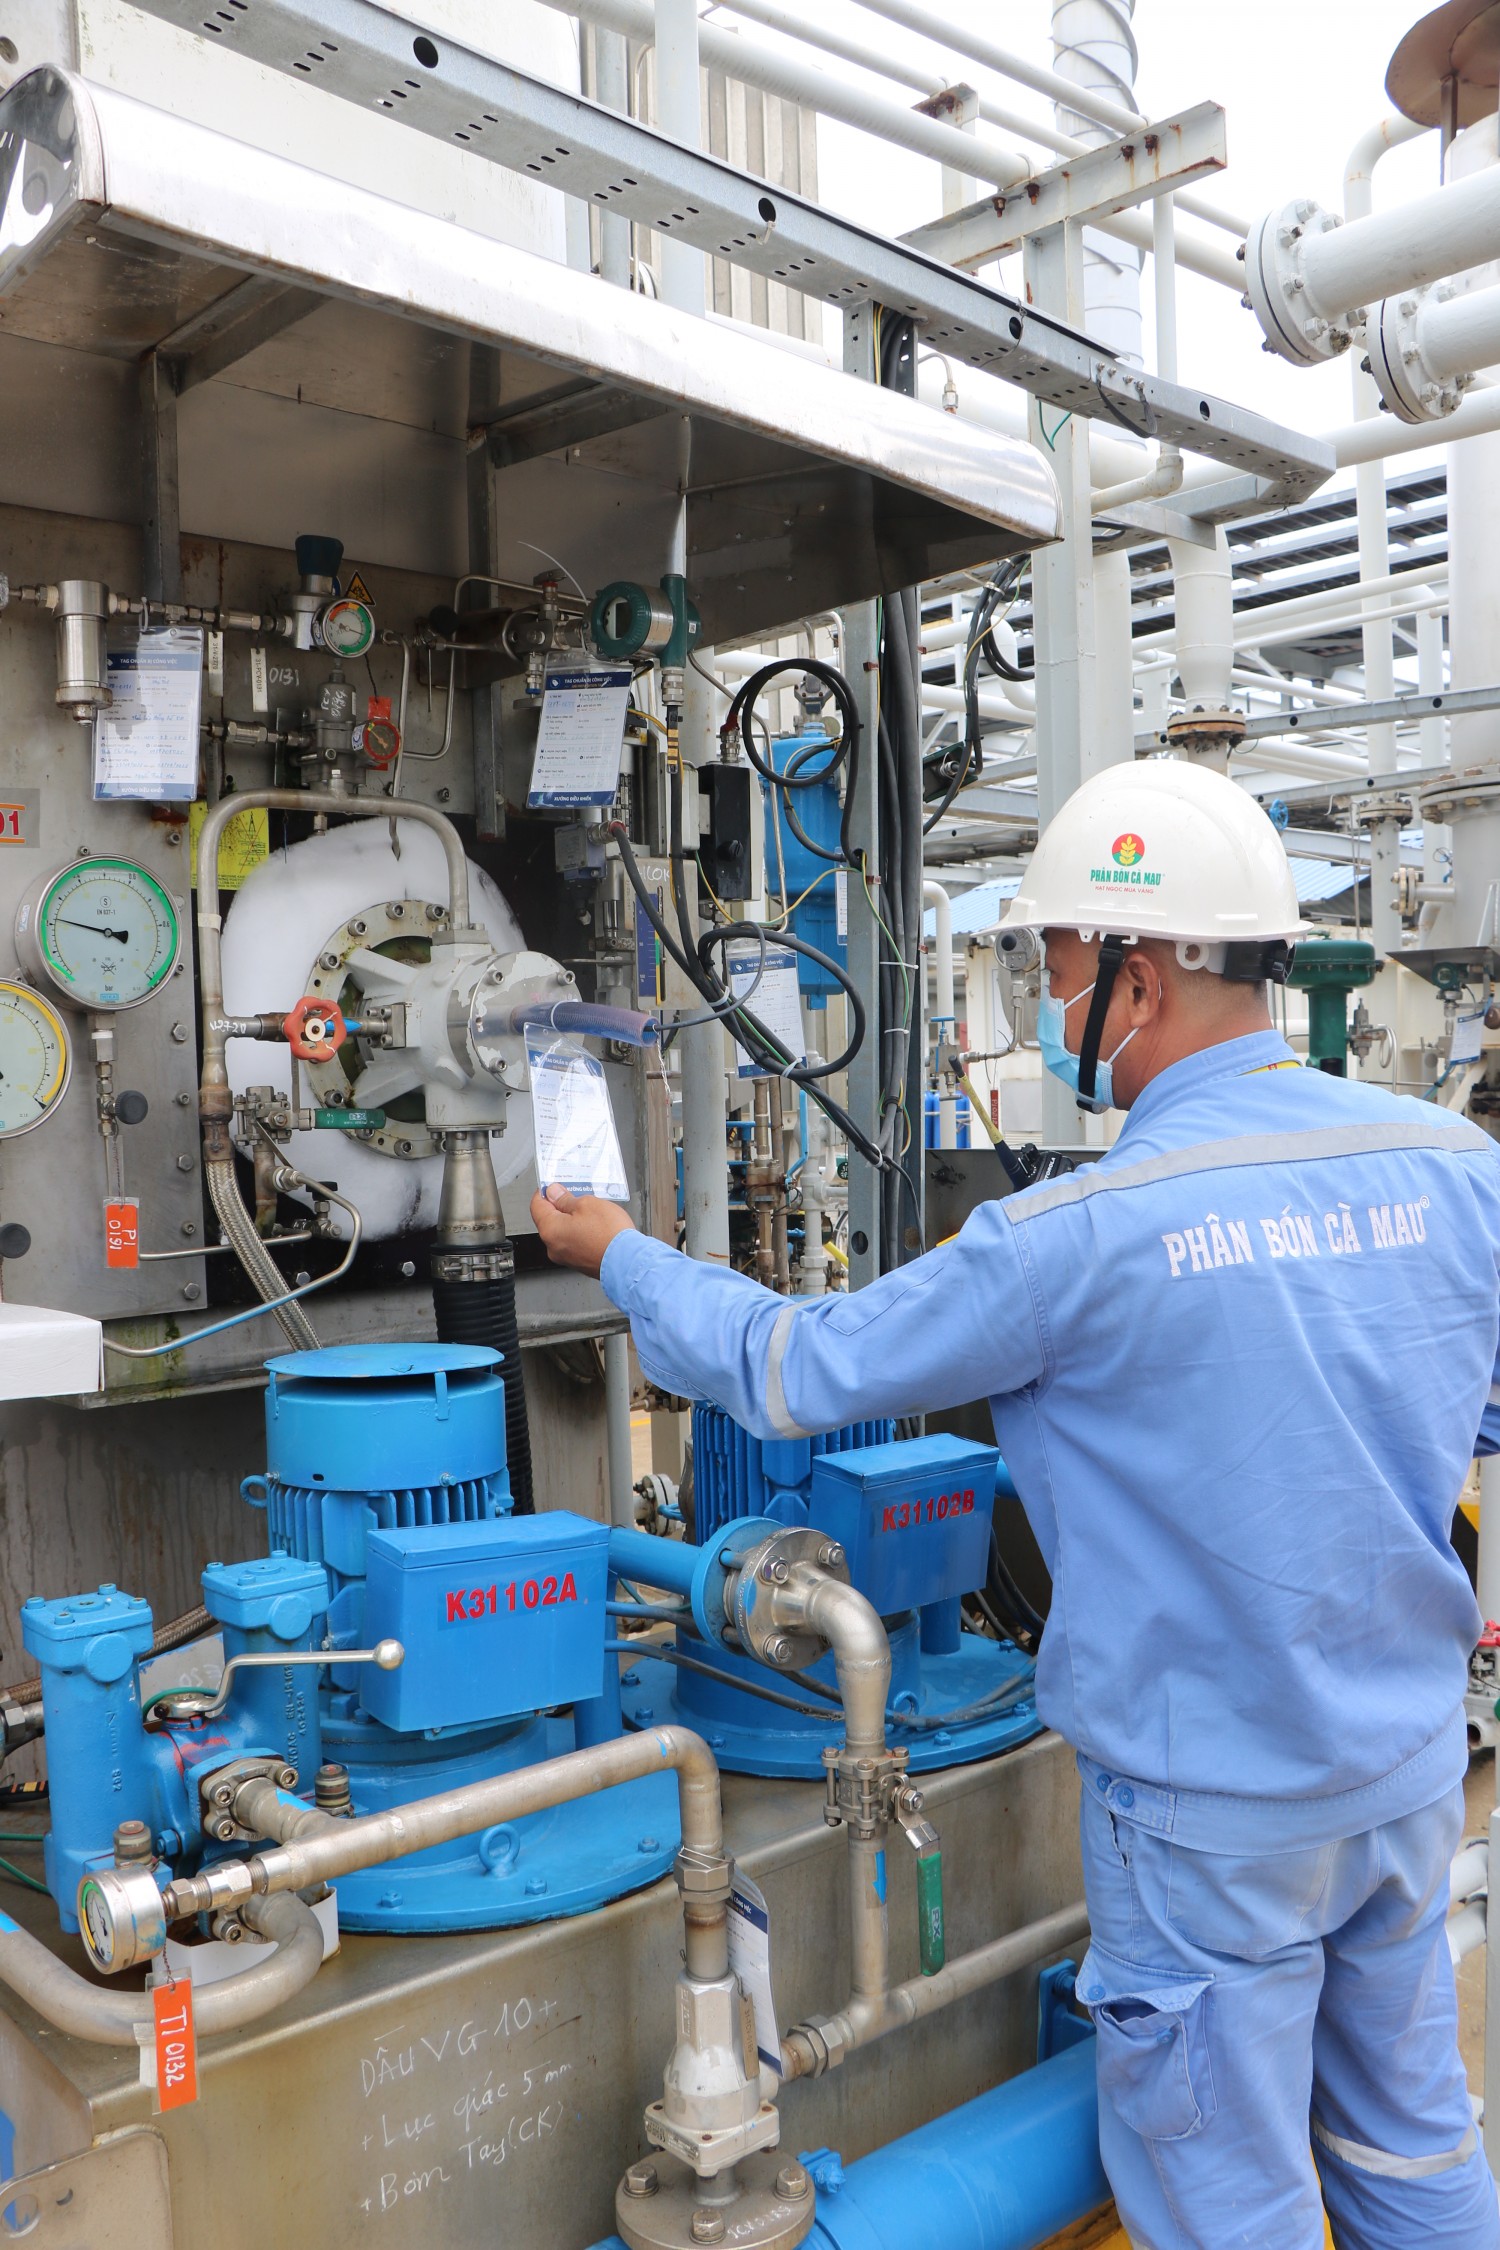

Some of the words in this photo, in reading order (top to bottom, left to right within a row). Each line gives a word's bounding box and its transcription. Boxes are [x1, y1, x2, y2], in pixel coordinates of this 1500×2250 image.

[1143, 872, 1161, 886] MAU
[1162, 1212, 1254, 1277] PHÂN
[1260, 1204, 1320, 1258] BÓN
[1323, 1201, 1362, 1254] CÀ
[1368, 1202, 1427, 1249] MAU
[881, 1488, 976, 1533] K31102B
[446, 1572, 578, 1623] K31102A
[421, 2021, 487, 2061] VG
[165, 2043, 185, 2087] 0132
